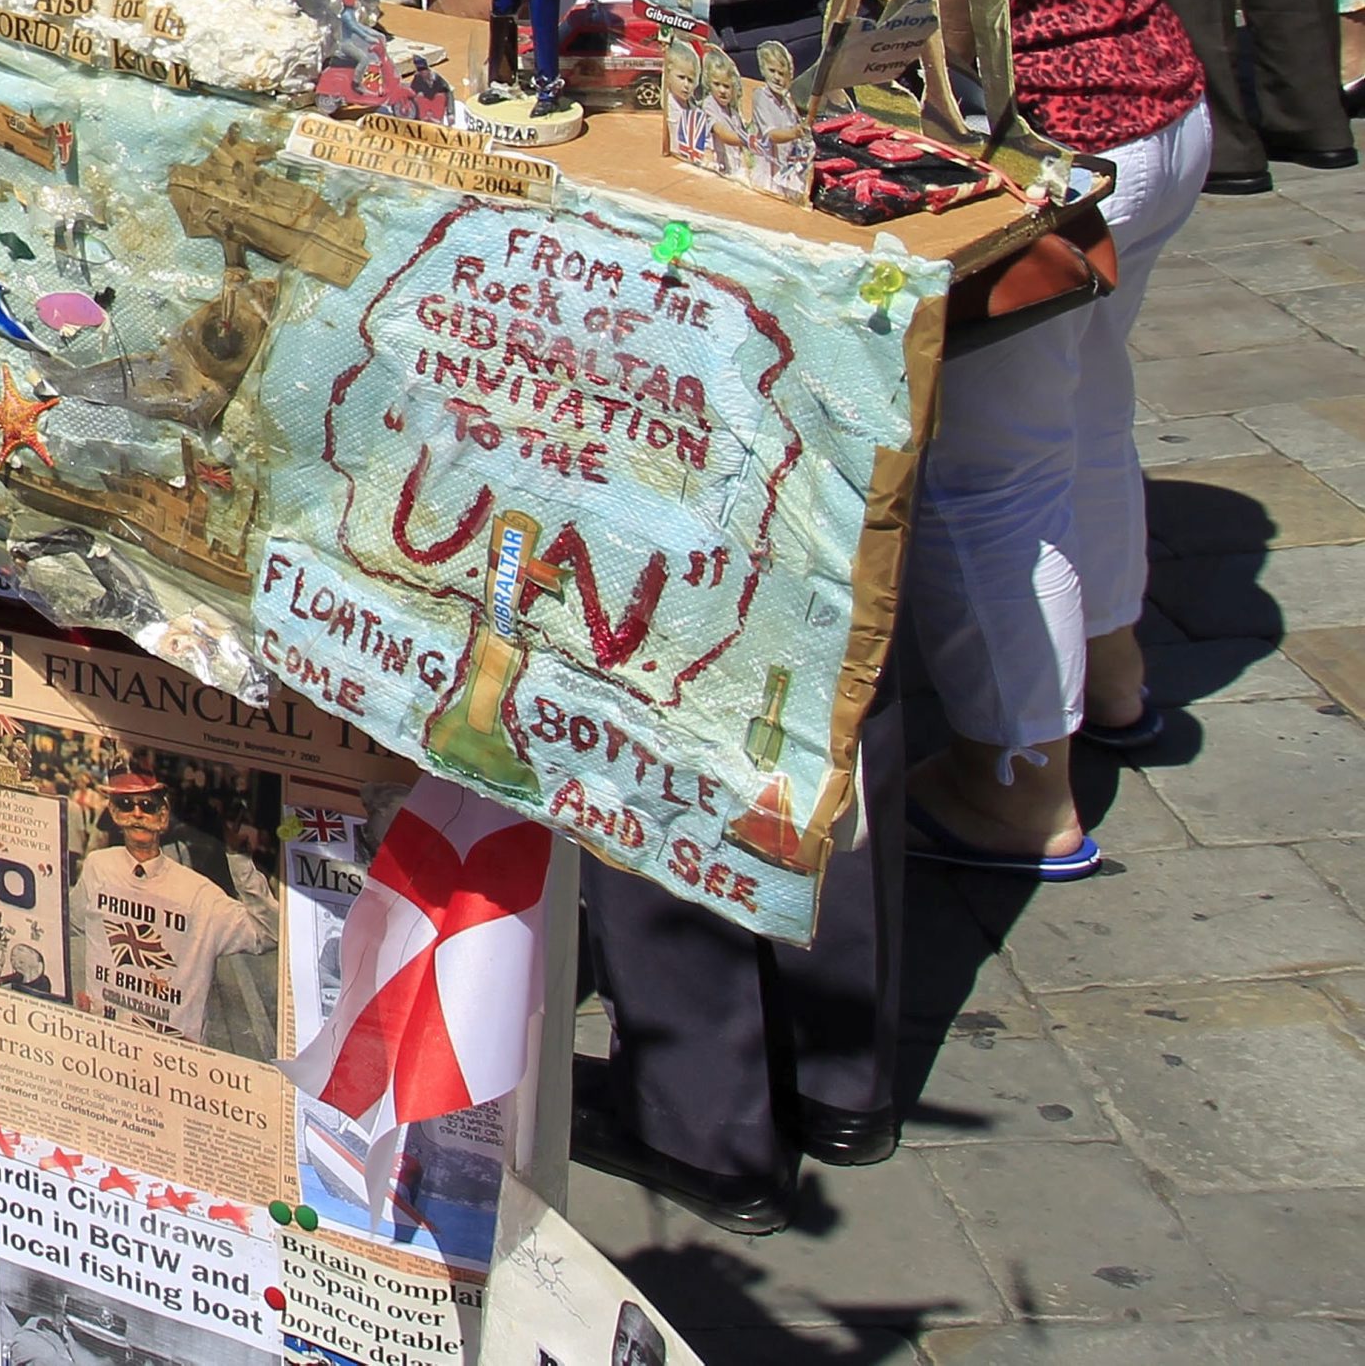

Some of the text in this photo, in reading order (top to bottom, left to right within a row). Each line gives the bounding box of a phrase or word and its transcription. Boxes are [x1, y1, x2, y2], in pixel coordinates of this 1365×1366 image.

[644, 6, 696, 31] Gibraltar
[362, 114, 428, 144] ROYAL
[311, 142, 524, 197] OF THE CITY IN 2004
[452, 256, 651, 343] Rock OF
[504, 228, 715, 331] FROM THE
[416, 295, 708, 415] GIBRALTAR
[415, 348, 714, 470] INVITATION
[519, 427, 610, 485] THE
[493, 527, 525, 639] GIBRALTAR
[262, 555, 450, 692] FLOATING
[42, 653, 313, 741] FINANCIAL
[262, 631, 367, 714] COME
[531, 696, 725, 816] BOTTLE
[550, 778, 648, 850] AND
[98, 893, 186, 932] PROUD TO
[296, 854, 364, 897] Mrs
[95, 965, 182, 1005] BE BRITISH
[27, 1009, 144, 1061] Gibraltar
[152, 1051, 200, 1078] sets
[208, 1065, 253, 1094] out
[60, 1101, 118, 1128] Christopher
[61, 1051, 161, 1099] colonial
[169, 1087, 269, 1131] masters
[53, 1211, 79, 1240] in
[89, 1225, 182, 1273] BGTW
[191, 1260, 251, 1296] and
[67, 1187, 130, 1227] Civil
[139, 1212, 235, 1258] draws
[281, 1234, 369, 1280] Britain
[2, 1224, 70, 1268] local
[80, 1252, 183, 1312] fishing
[193, 1290, 264, 1334] boat
[282, 1256, 447, 1329] to Spain over
[281, 1308, 364, 1354] border
